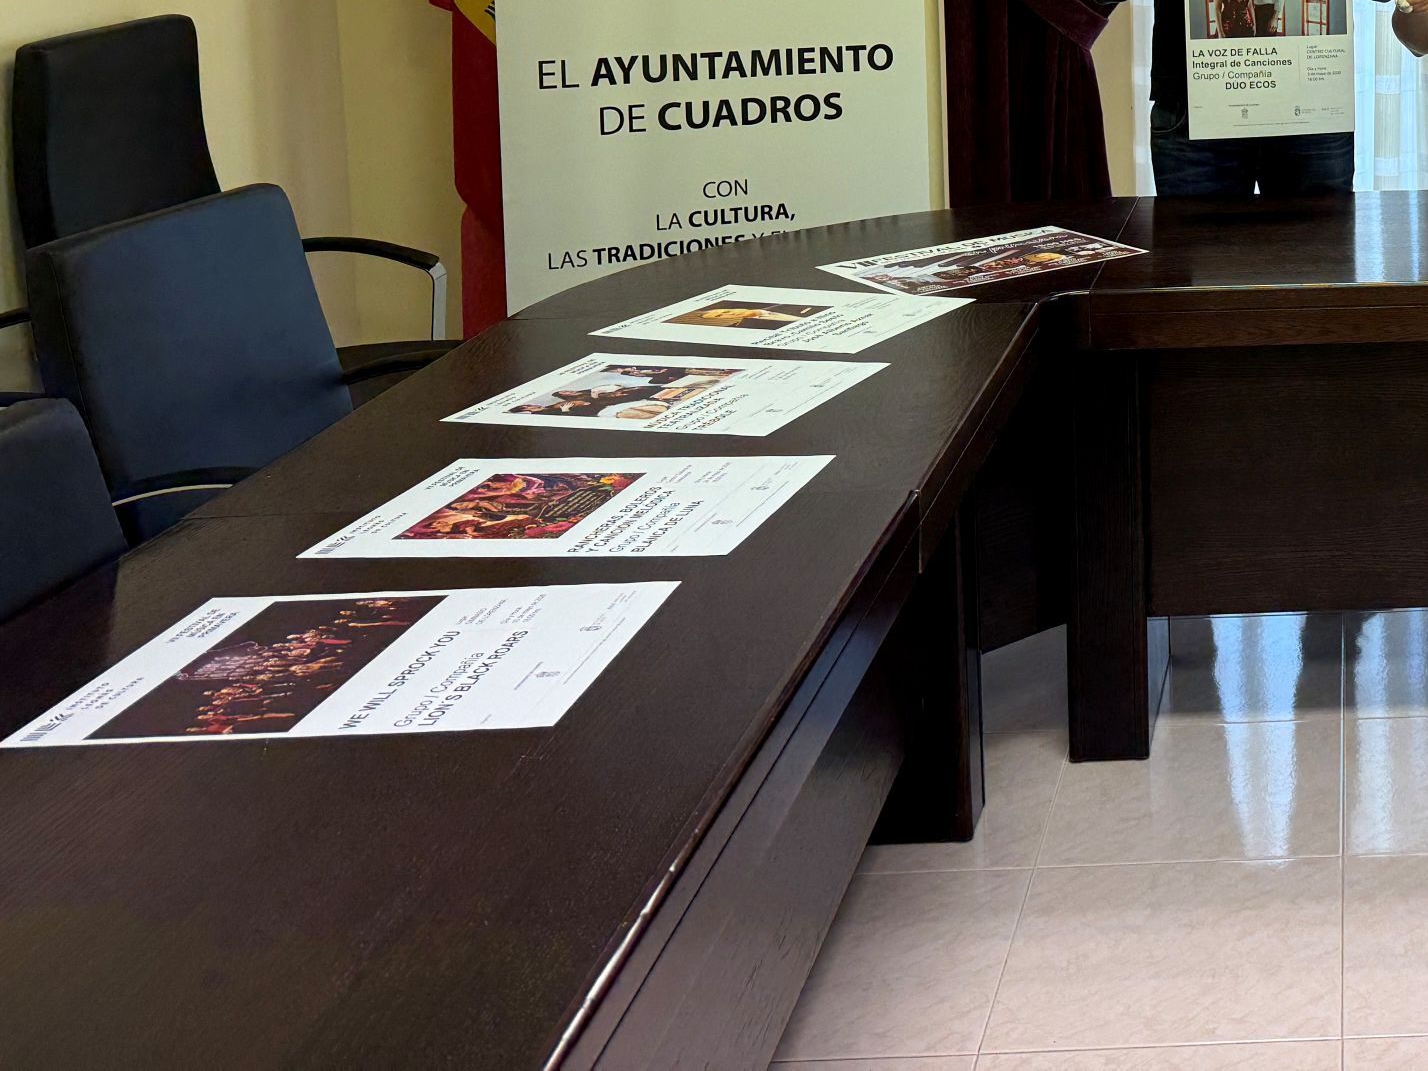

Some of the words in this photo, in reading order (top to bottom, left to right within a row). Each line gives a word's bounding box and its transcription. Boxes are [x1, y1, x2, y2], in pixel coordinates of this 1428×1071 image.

[537, 59, 580, 90] EL
[590, 43, 894, 87] AYUNTAMIENTO
[1192, 49, 1205, 58] LA
[1207, 48, 1227, 58] VOZ
[1230, 48, 1244, 57] DE
[1246, 47, 1278, 56] FALLA
[1192, 59, 1227, 70] Integral
[1230, 59, 1241, 68] de
[1244, 58, 1293, 68] Canciones
[1193, 71, 1220, 82] Grupo
[1227, 70, 1272, 81] Compañía
[1249, 80, 1277, 89] ECOS
[599, 104, 647, 136] DE
[658, 92, 843, 131] CUADROS
[702, 179, 749, 199] CON
[656, 213, 683, 231] LA
[688, 202, 796, 229] CULTURA,
[548, 250, 588, 270] LAS
[567, 514, 627, 553] RANCHERAS,
[619, 487, 662, 513] BOLEROS
[630, 527, 672, 552] BLANCA
[664, 517, 683, 526] DE
[676, 500, 704, 516] LUNA
[609, 534, 640, 553] Grupo
[453, 661, 497, 692] BLACK
[487, 631, 528, 660] ROARS
[338, 713, 370, 729] WE
[358, 689, 397, 711] WILL
[388, 650, 440, 687] SPROCK
[429, 631, 460, 648] YOU
[393, 700, 433, 727] Grupo
[430, 652, 485, 693] Compañía
